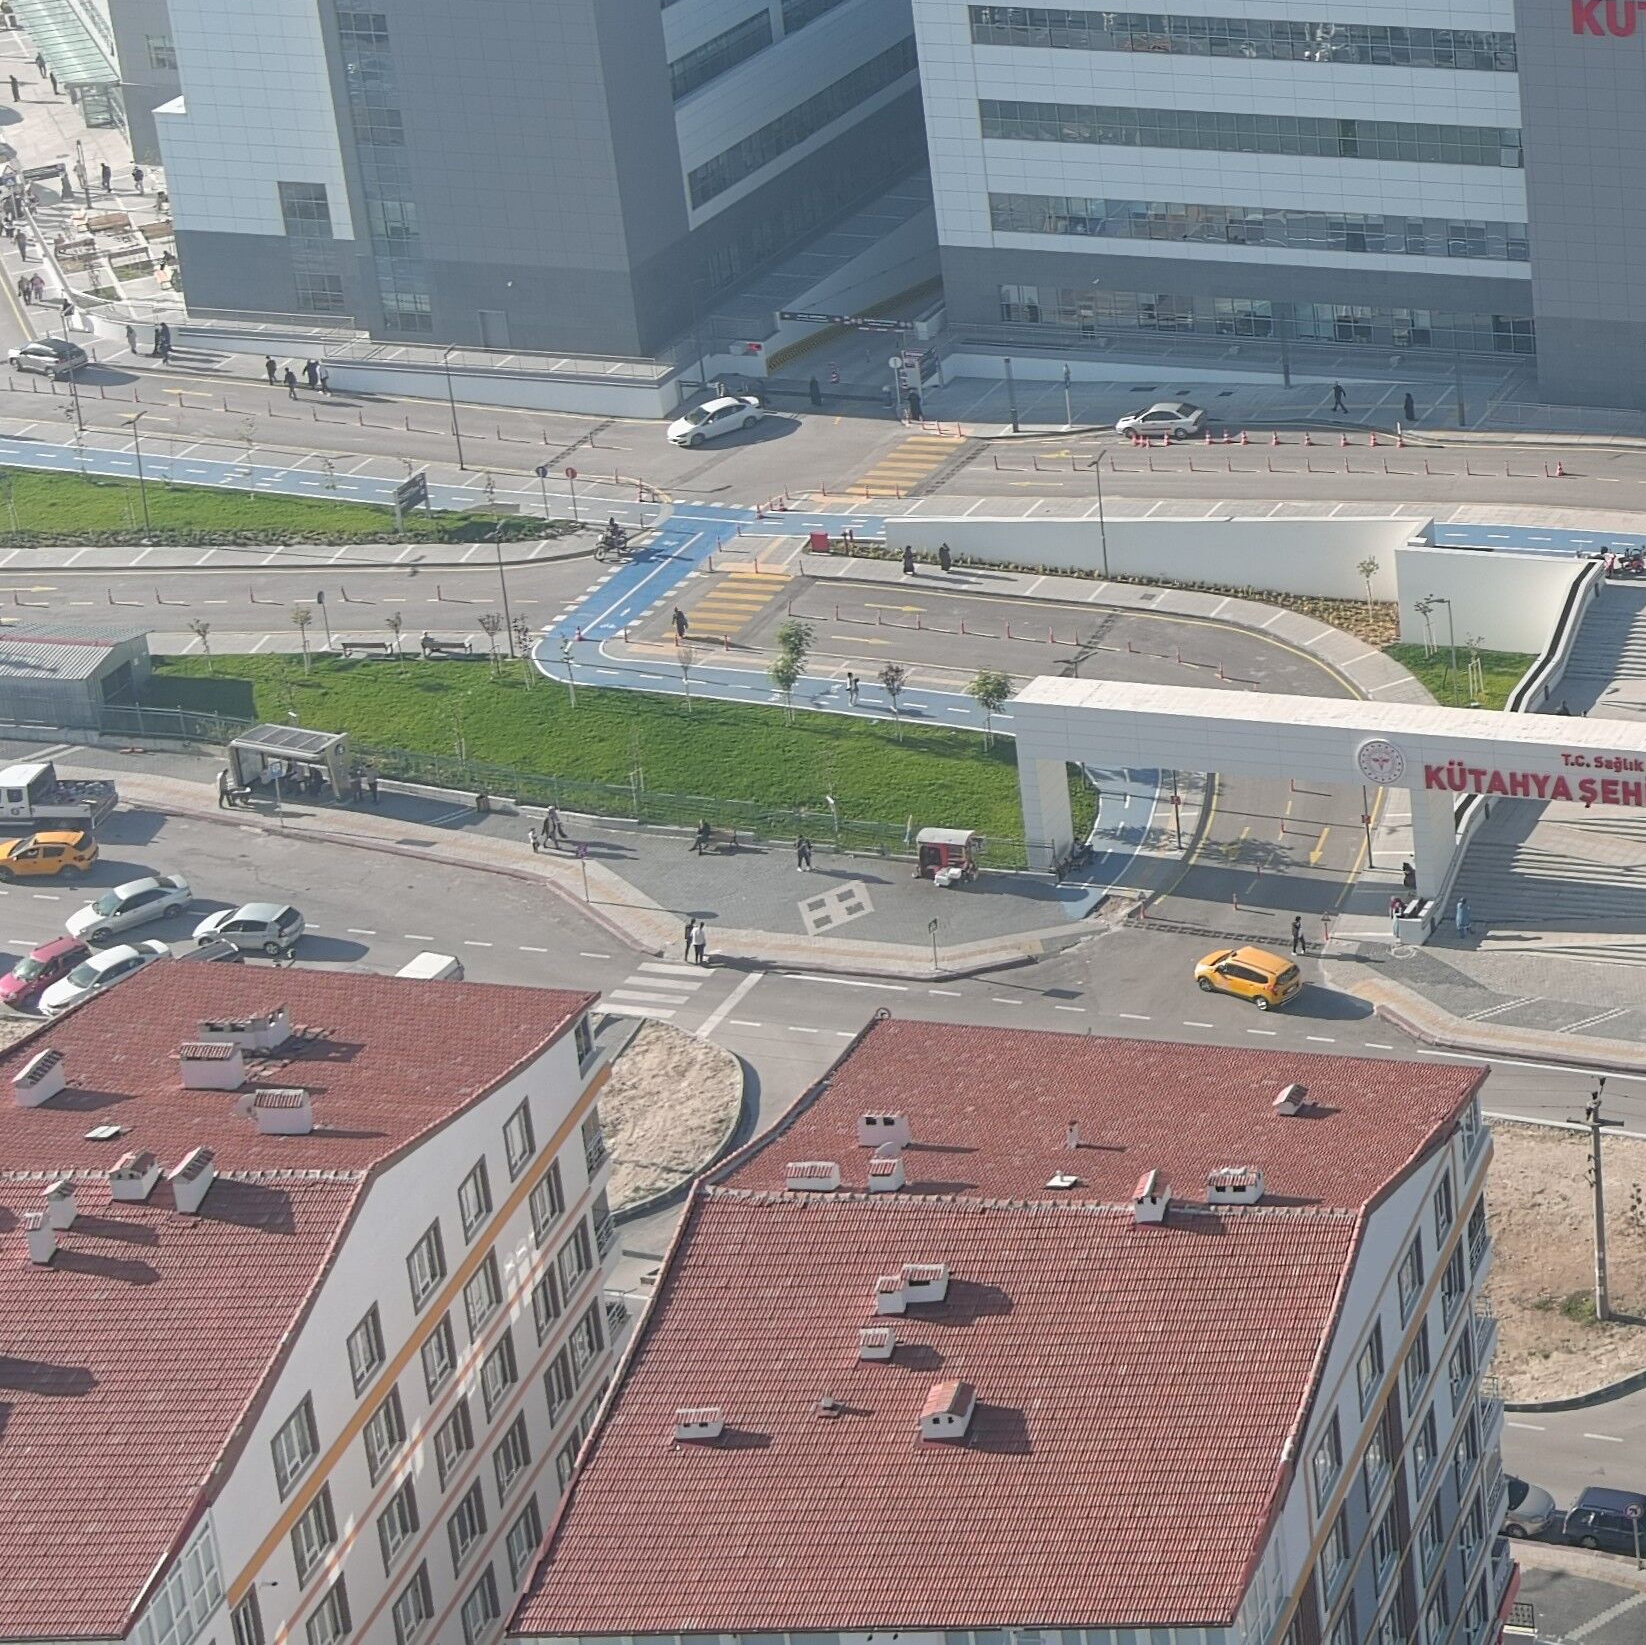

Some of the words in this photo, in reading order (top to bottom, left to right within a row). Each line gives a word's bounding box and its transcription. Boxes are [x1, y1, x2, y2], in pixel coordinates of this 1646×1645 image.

[1561, 753, 1591, 769] T.C.
[1594, 756, 1645, 772] Sağlık
[1424, 760, 1573, 800] KÜTAHYA
